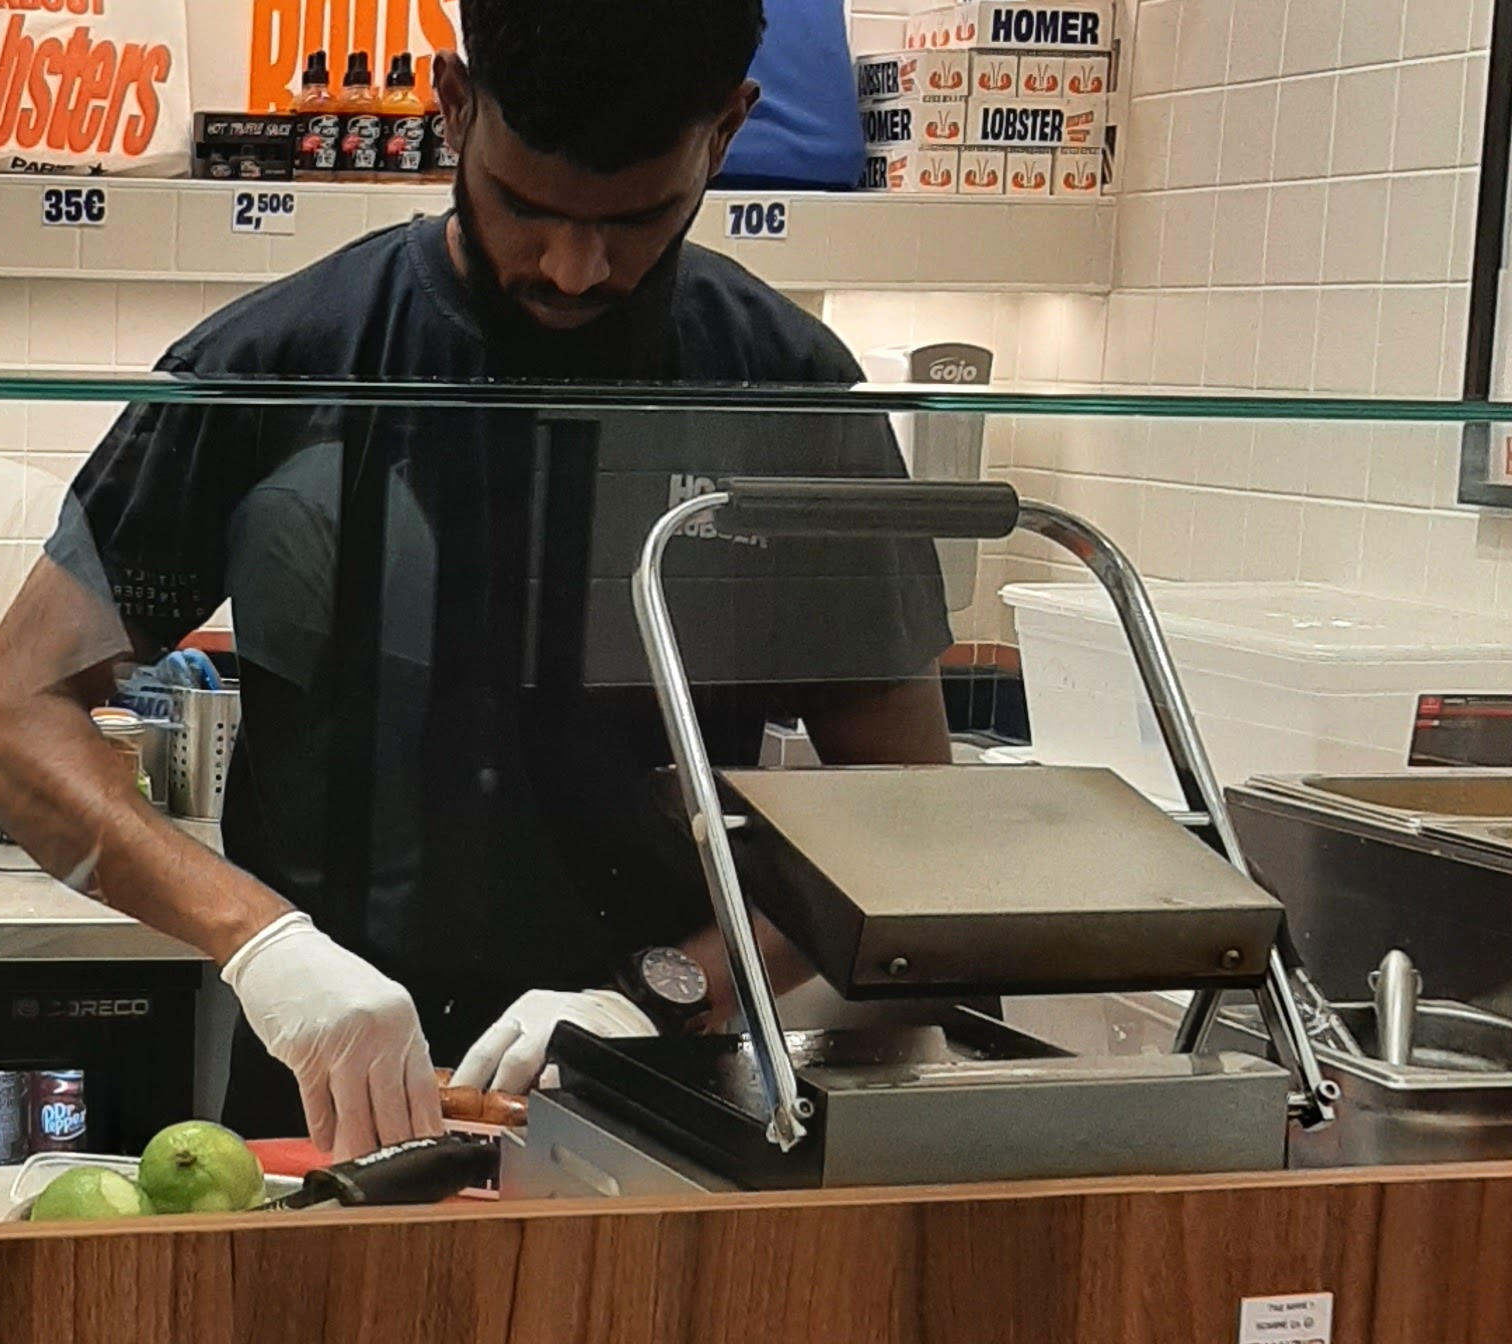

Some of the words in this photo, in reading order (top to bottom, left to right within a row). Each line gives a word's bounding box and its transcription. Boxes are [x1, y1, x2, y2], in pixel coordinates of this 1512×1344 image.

[991, 9, 1099, 45] HOMER
[981, 108, 1064, 142] LOBSTER
[44, 188, 105, 223] 35€
[729, 202, 786, 236] 70€
